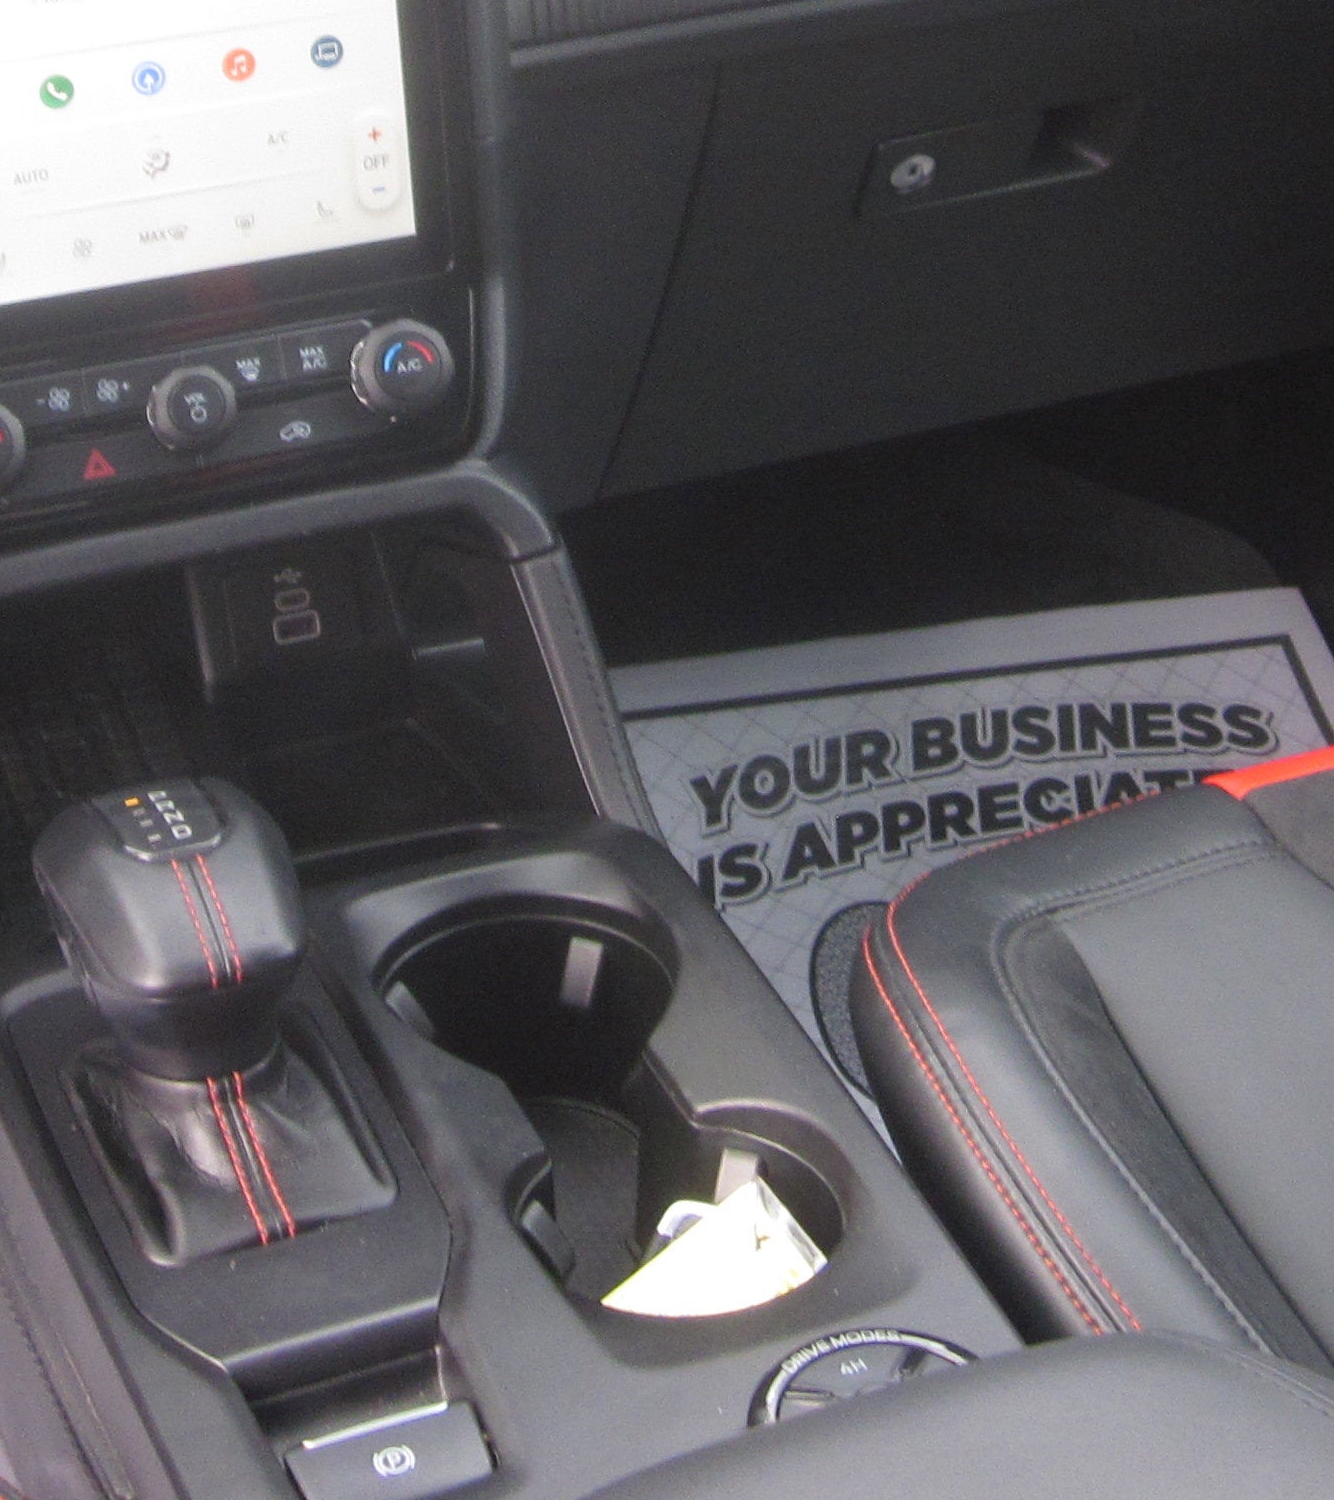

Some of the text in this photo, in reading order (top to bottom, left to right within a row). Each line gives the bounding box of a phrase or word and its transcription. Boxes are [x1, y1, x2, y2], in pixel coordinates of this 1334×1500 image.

[363, 153, 390, 172] OFF
[13, 167, 49, 187] AUTO
[138, 228, 167, 245] MAX
[299, 345, 324, 359] MAX
[235, 357, 261, 371] MAX
[302, 357, 327, 372] A/C
[397, 358, 422, 373] A/C
[690, 702, 1273, 828] YOUR BUSINESS
[698, 842, 763, 906] IS
[782, 1329, 901, 1375] DRIVE MODES
[839, 1357, 869, 1375] 4H
